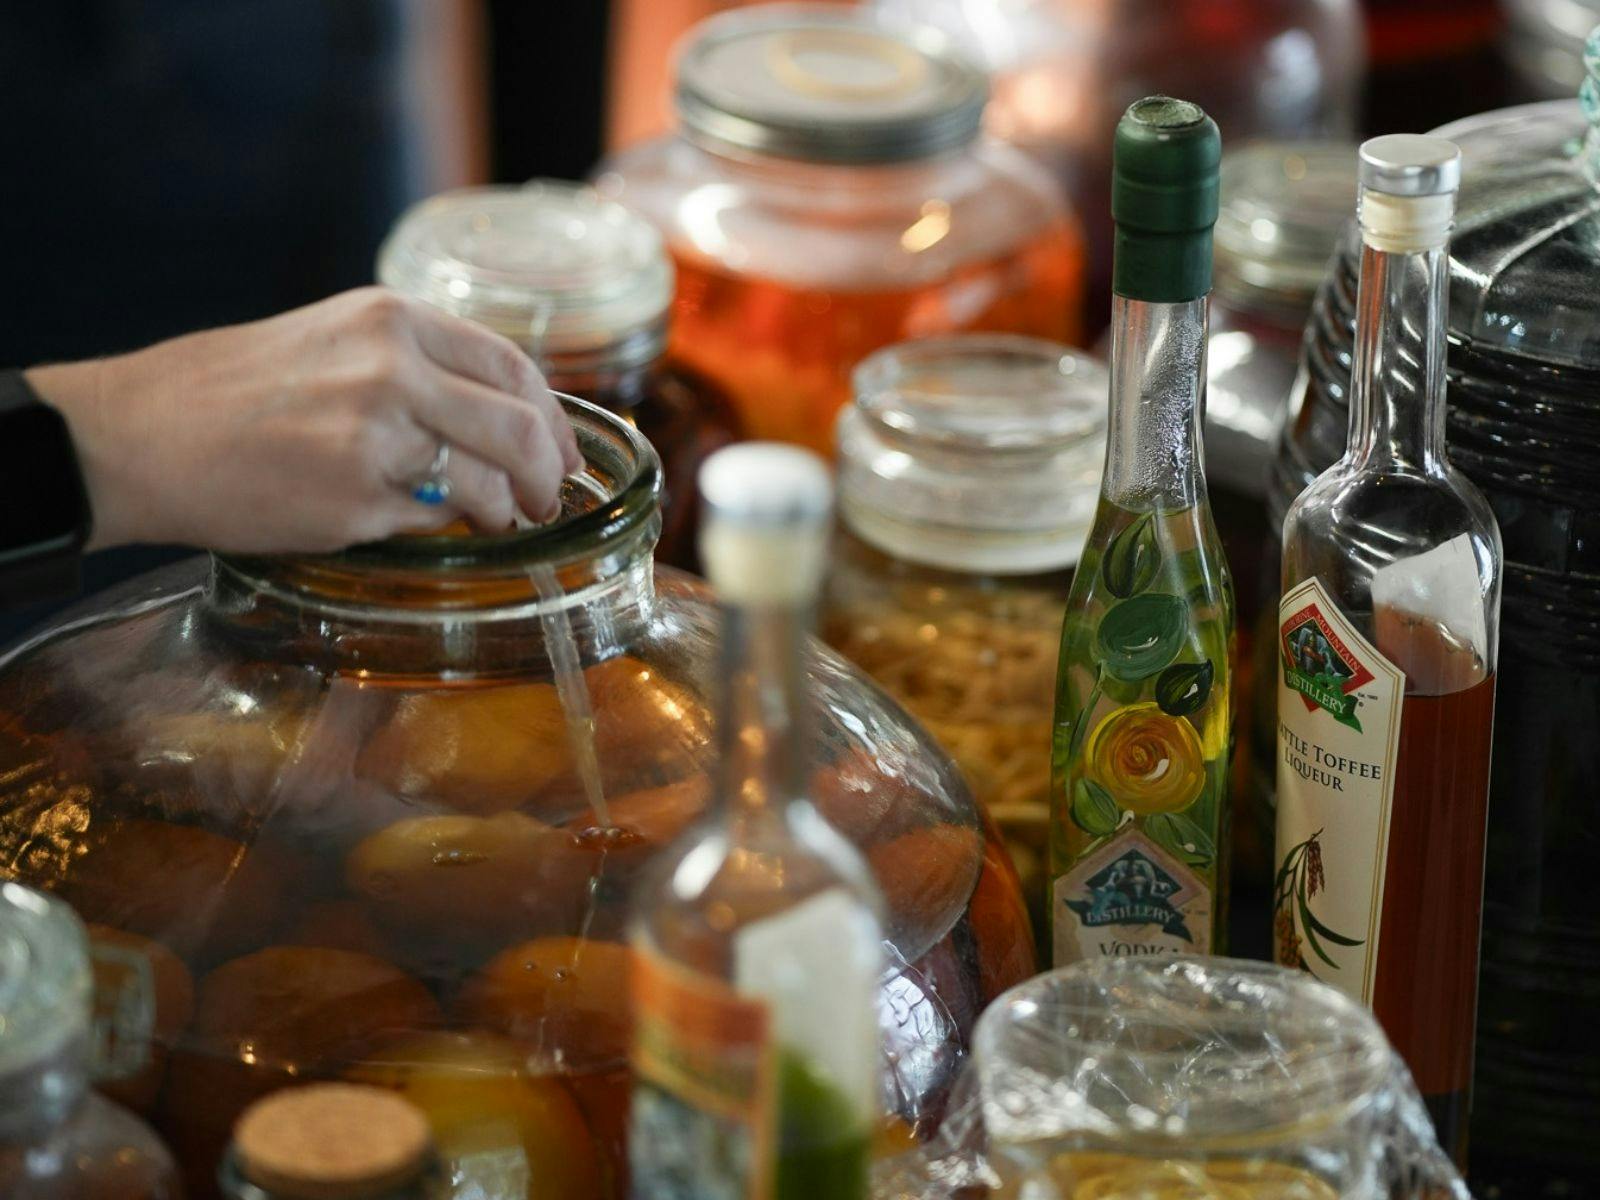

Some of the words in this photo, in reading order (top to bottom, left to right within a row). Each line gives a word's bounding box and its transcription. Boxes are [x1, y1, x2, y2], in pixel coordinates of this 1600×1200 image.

[1316, 613, 1361, 671] MOUNTAIN
[1286, 670, 1347, 714] DISTILLERY
[1284, 746, 1344, 792] LIQUEUR
[1313, 744, 1382, 780] TOFFEE
[1099, 940, 1179, 956] VODK
